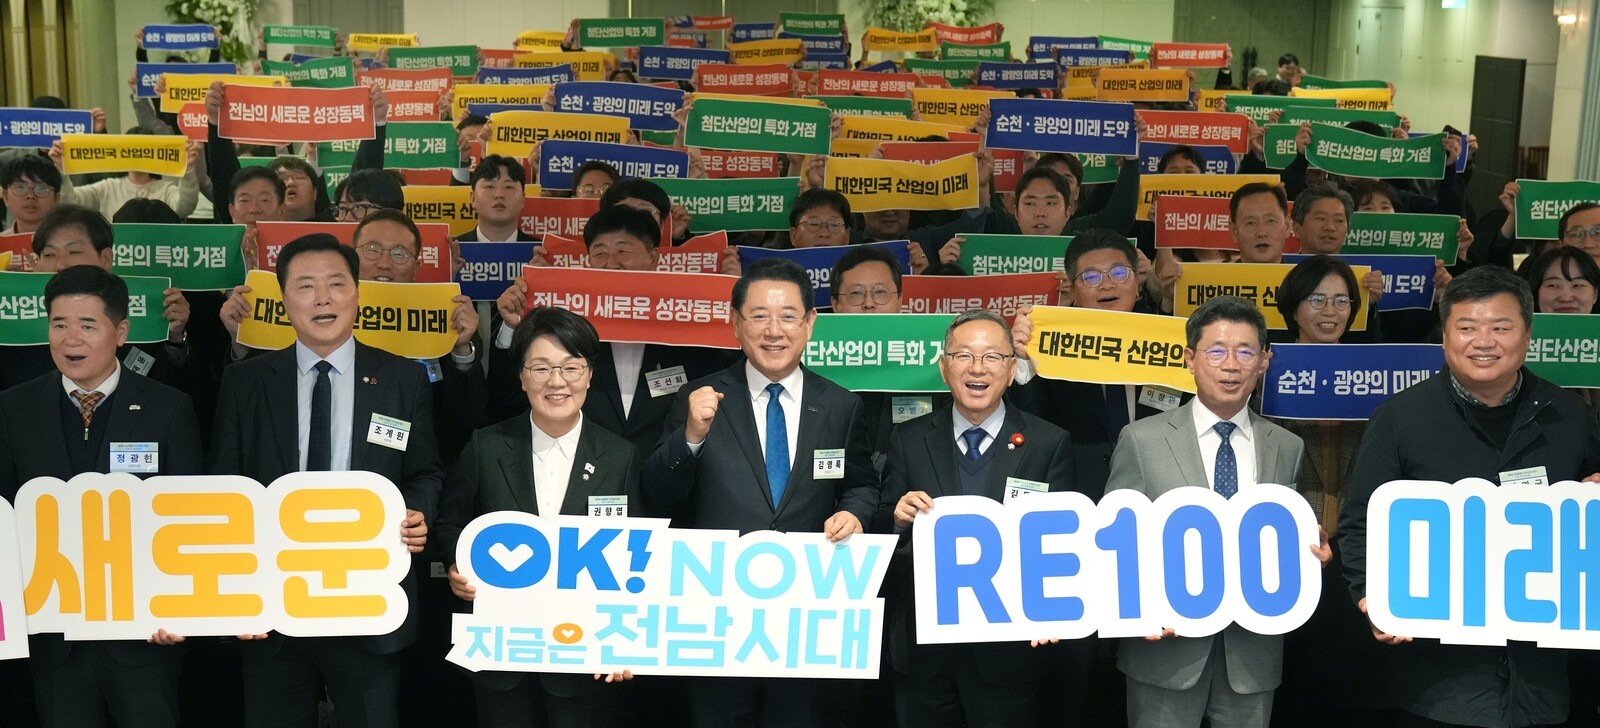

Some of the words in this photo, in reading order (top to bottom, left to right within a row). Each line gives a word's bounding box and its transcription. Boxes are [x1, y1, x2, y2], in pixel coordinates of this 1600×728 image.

[146, 33, 160, 42] 순천
[165, 33, 185, 43] 광양의
[186, 33, 200, 42] 미래
[201, 33, 214, 42] 도약
[317, 29, 330, 40] 거점
[588, 27, 624, 38] 첨단산업의
[625, 27, 640, 37] 특화
[641, 26, 656, 37] 거점
[870, 36, 896, 44] 대한민국
[918, 35, 931, 43] 미래
[991, 48, 1004, 57] 거점
[1033, 44, 1045, 52] 순천
[1158, 50, 1177, 59] 전남의
[1178, 50, 1196, 59] 새로운
[1198, 50, 1223, 59] 성장동력
[396, 56, 435, 68] 첨단산업의
[437, 57, 453, 67] 특화
[454, 56, 470, 66] 거점
[582, 61, 599, 72] 미래
[644, 57, 660, 68] 순천
[666, 58, 690, 69] 광양의
[1060, 56, 1074, 66] 순천
[1079, 56, 1097, 66] 광양의
[1099, 57, 1111, 66] 미래
[310, 68, 328, 80] 특화
[330, 66, 346, 77] 거점
[552, 74, 568, 84] 도약
[703, 75, 727, 86] 전남의
[729, 74, 753, 85] 새로운
[755, 73, 788, 85] 성장동력
[945, 70, 959, 79] 특화
[981, 71, 996, 80] 순천
[1002, 71, 1023, 80] 광양의
[1024, 71, 1038, 80] 미래
[1040, 70, 1054, 80] 도약
[387, 79, 413, 90] 새로운
[414, 78, 448, 91] 성장동력
[823, 79, 850, 91] 전남의
[852, 79, 878, 91] 새로운
[880, 80, 915, 92] 성장동력
[1103, 80, 1136, 90] 대한민국
[1139, 80, 1164, 90] 산업의
[1165, 80, 1182, 90] 미래
[229, 102, 267, 122] 전남의
[271, 104, 310, 124] 새로운
[313, 104, 365, 124] 성장동력
[394, 103, 434, 116] 성장동력
[560, 96, 583, 110] 순천
[592, 97, 626, 112] 광양의
[628, 100, 650, 114] 미래
[653, 102, 676, 116] 도약
[918, 102, 957, 115] 대한민국
[10, 121, 41, 135] 광양의
[42, 122, 62, 136] 미래
[64, 123, 85, 134] 도약
[701, 115, 762, 135] 첨단산업의
[764, 119, 789, 137] 특화
[791, 122, 817, 138] 거점
[996, 115, 1022, 132] 순천
[1034, 116, 1072, 135] 광양의
[1075, 119, 1100, 136] 미래
[1102, 120, 1130, 138] 도약
[1169, 126, 1199, 139] 새로운
[1202, 126, 1242, 140] 성장동력
[497, 126, 550, 144] 대한민국
[395, 138, 420, 154] 특화
[422, 138, 447, 153] 거점
[1316, 140, 1377, 162] 첨단산업의
[1379, 147, 1404, 163] 특화
[1406, 148, 1431, 163] 거점
[70, 148, 116, 160] 대한민국
[120, 148, 154, 160] 산업의
[157, 149, 179, 162] 미래
[548, 156, 574, 173] 순천
[626, 162, 651, 178] 미래
[654, 164, 679, 178] 도약
[727, 156, 773, 172] 성장동력
[1205, 161, 1228, 174] 도약
[835, 176, 892, 195] 대한민국
[896, 179, 938, 196] 산업의
[942, 173, 968, 195] 미래
[668, 195, 724, 214] 단산업의
[727, 195, 754, 214] 특화
[757, 195, 784, 213] 거점
[521, 216, 561, 235] 전남의
[1165, 213, 1201, 231] 전남의
[1204, 214, 1230, 231] 새로
[1389, 231, 1415, 247] 특화
[1417, 232, 1445, 249] 거점
[155, 245, 189, 268] 특화
[193, 247, 226, 268] 거점
[657, 253, 718, 273] 성장동력
[460, 262, 502, 281] 광양의
[1395, 275, 1426, 294] 도약
[594, 295, 651, 320] 새로운
[656, 298, 731, 323] 성장동력
[408, 309, 447, 334] 미래
[801, 340, 882, 366] 단산업의
[887, 341, 925, 366] 특화
[1038, 331, 1122, 362] 대한민국
[1127, 339, 1187, 369] 산업의
[1278, 370, 1316, 395] 순천
[1333, 370, 1388, 395] 광양의
[23, 488, 390, 622] 새로운
[470, 522, 653, 594] OK!
[668, 540, 882, 600] NOW
[1388, 494, 1600, 631] 미래
[933, 501, 1302, 626] RE100
[464, 622, 587, 665] 지금은
[594, 604, 871, 669] 전남시대
